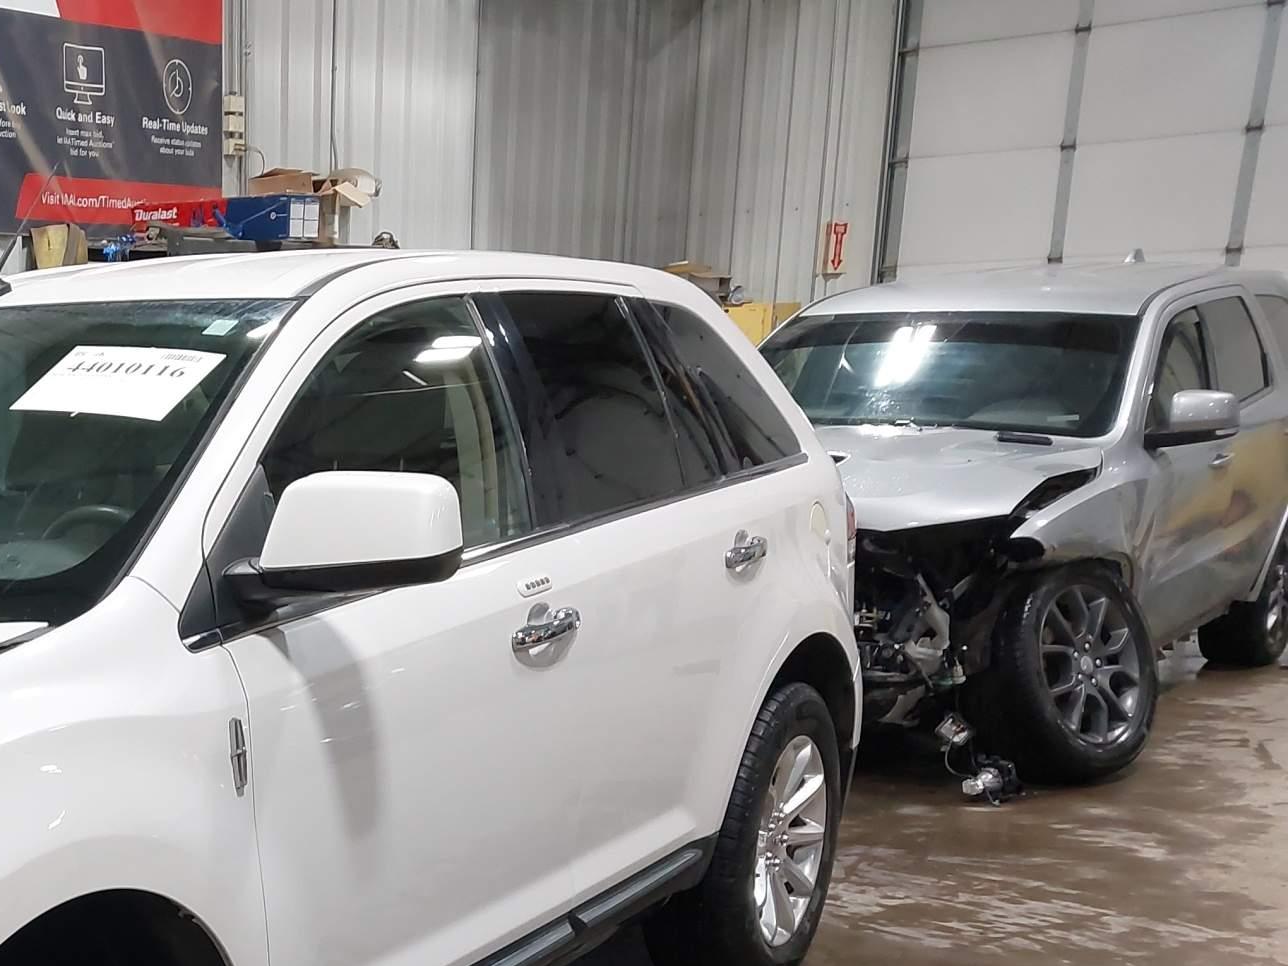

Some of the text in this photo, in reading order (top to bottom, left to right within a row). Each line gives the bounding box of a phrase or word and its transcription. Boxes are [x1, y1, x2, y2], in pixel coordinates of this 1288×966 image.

[56, 106, 115, 127] Quick and Easy
[142, 117, 208, 136] Real-Time Updates
[41, 191, 60, 206] Visit
[134, 207, 178, 221] Duralast
[66, 360, 186, 379] 44010116
